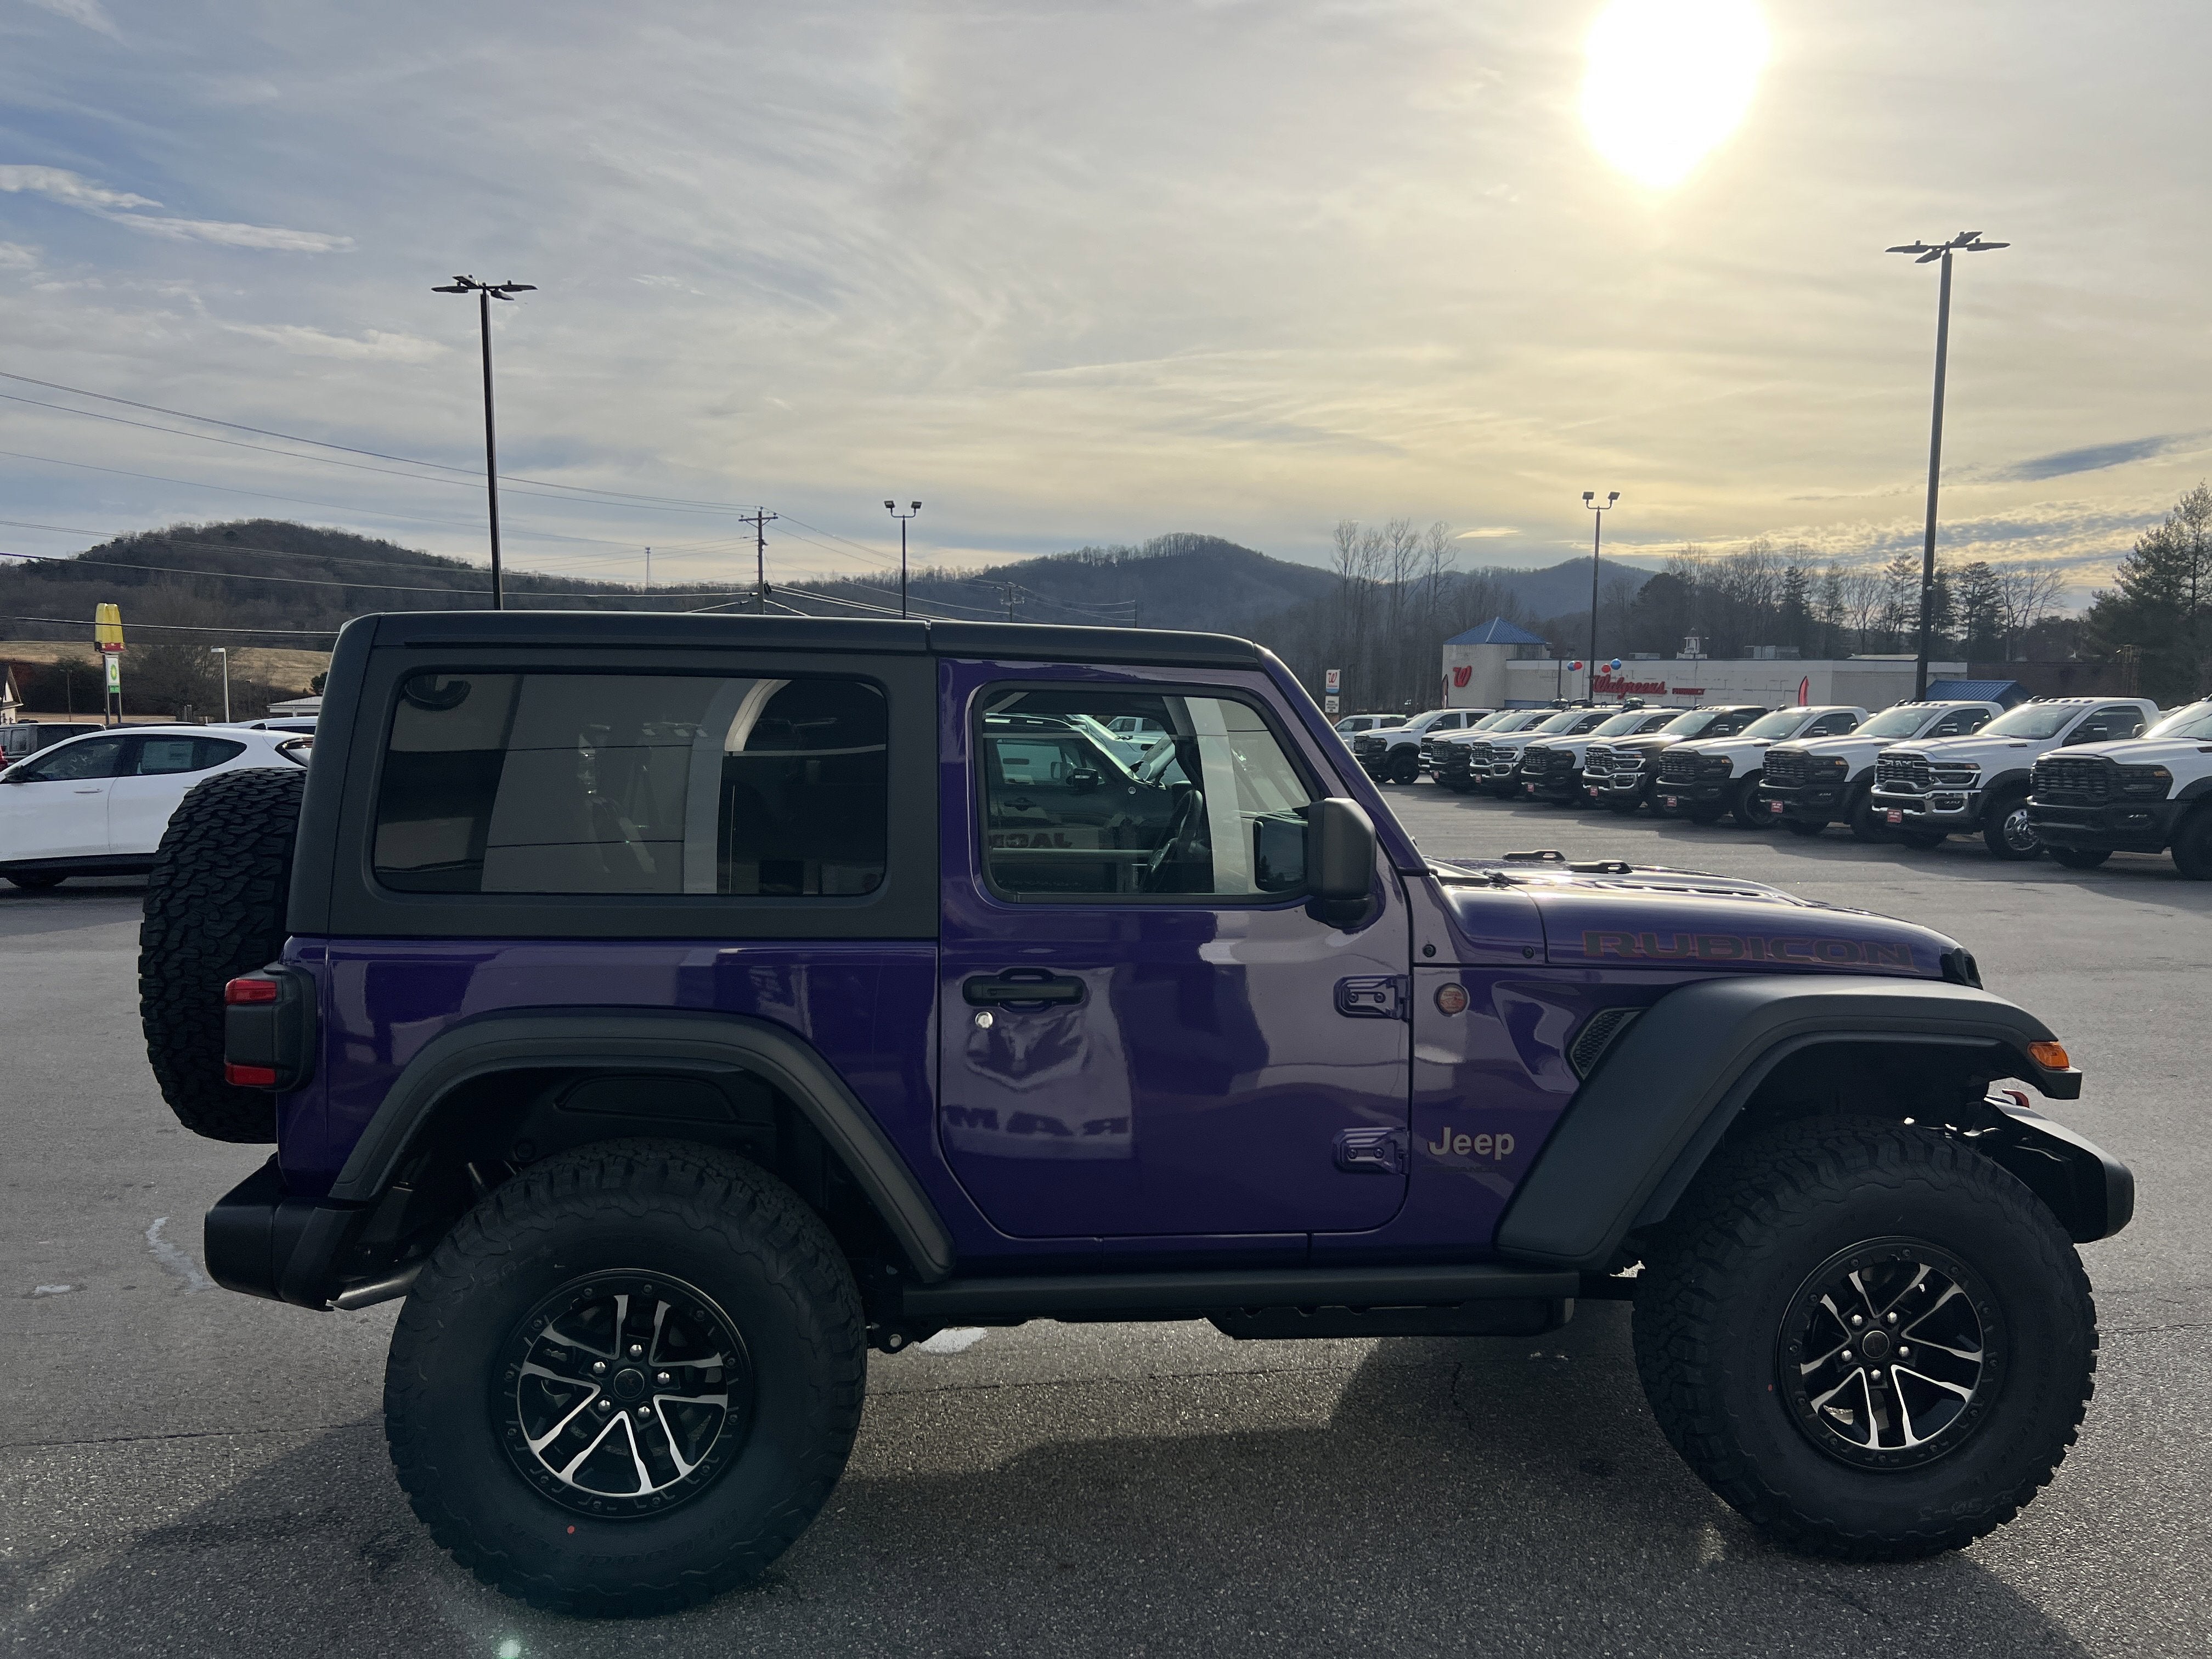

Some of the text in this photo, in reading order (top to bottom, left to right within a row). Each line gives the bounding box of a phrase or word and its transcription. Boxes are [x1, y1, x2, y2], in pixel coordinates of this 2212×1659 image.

[1328, 672, 1338, 684] W
[1453, 665, 1472, 687] W
[1593, 674, 1667, 699] Walgreens
[1582, 931, 1915, 968] RUBICON
[1428, 1127, 1515, 1160] Jeep
